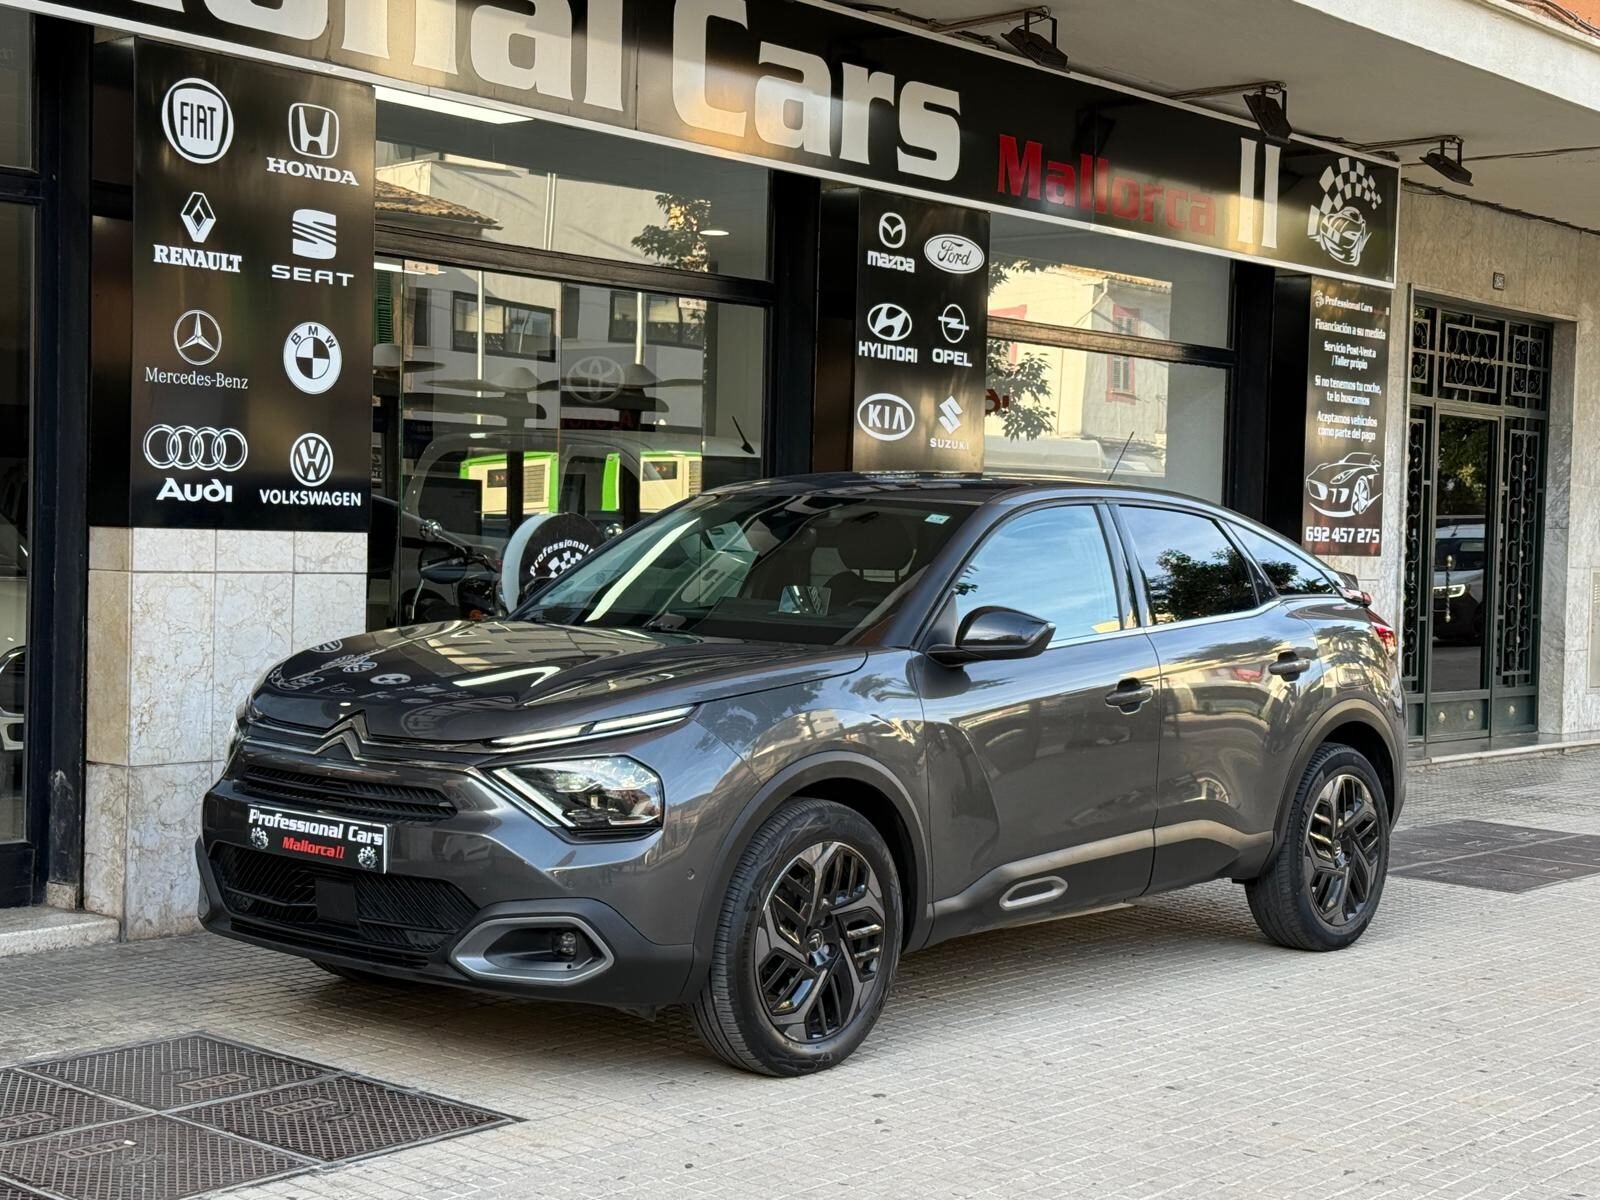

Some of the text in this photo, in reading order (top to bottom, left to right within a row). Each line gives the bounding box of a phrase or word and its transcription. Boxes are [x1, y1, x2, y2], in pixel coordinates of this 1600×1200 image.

[180, 102, 217, 142] FIAT
[671, 0, 962, 182] Cars
[997, 134, 1217, 236] Mallorca
[266, 157, 359, 187] HONDA
[153, 244, 242, 273] RENAULT
[936, 239, 971, 266] Ford
[271, 264, 354, 287] SEAT
[859, 341, 918, 364] HYUNDAI
[932, 348, 973, 368] OPEL
[144, 366, 249, 390] Mercedes-Benz
[930, 437, 969, 450] SUZUKI
[156, 477, 233, 502] Audi
[259, 489, 362, 506] VOLKSWAGEN
[1305, 526, 1380, 544] 692 457 275
[529, 539, 589, 577] Professional
[248, 808, 383, 846] Professional Cars
[282, 836, 335, 857] Mallorca
